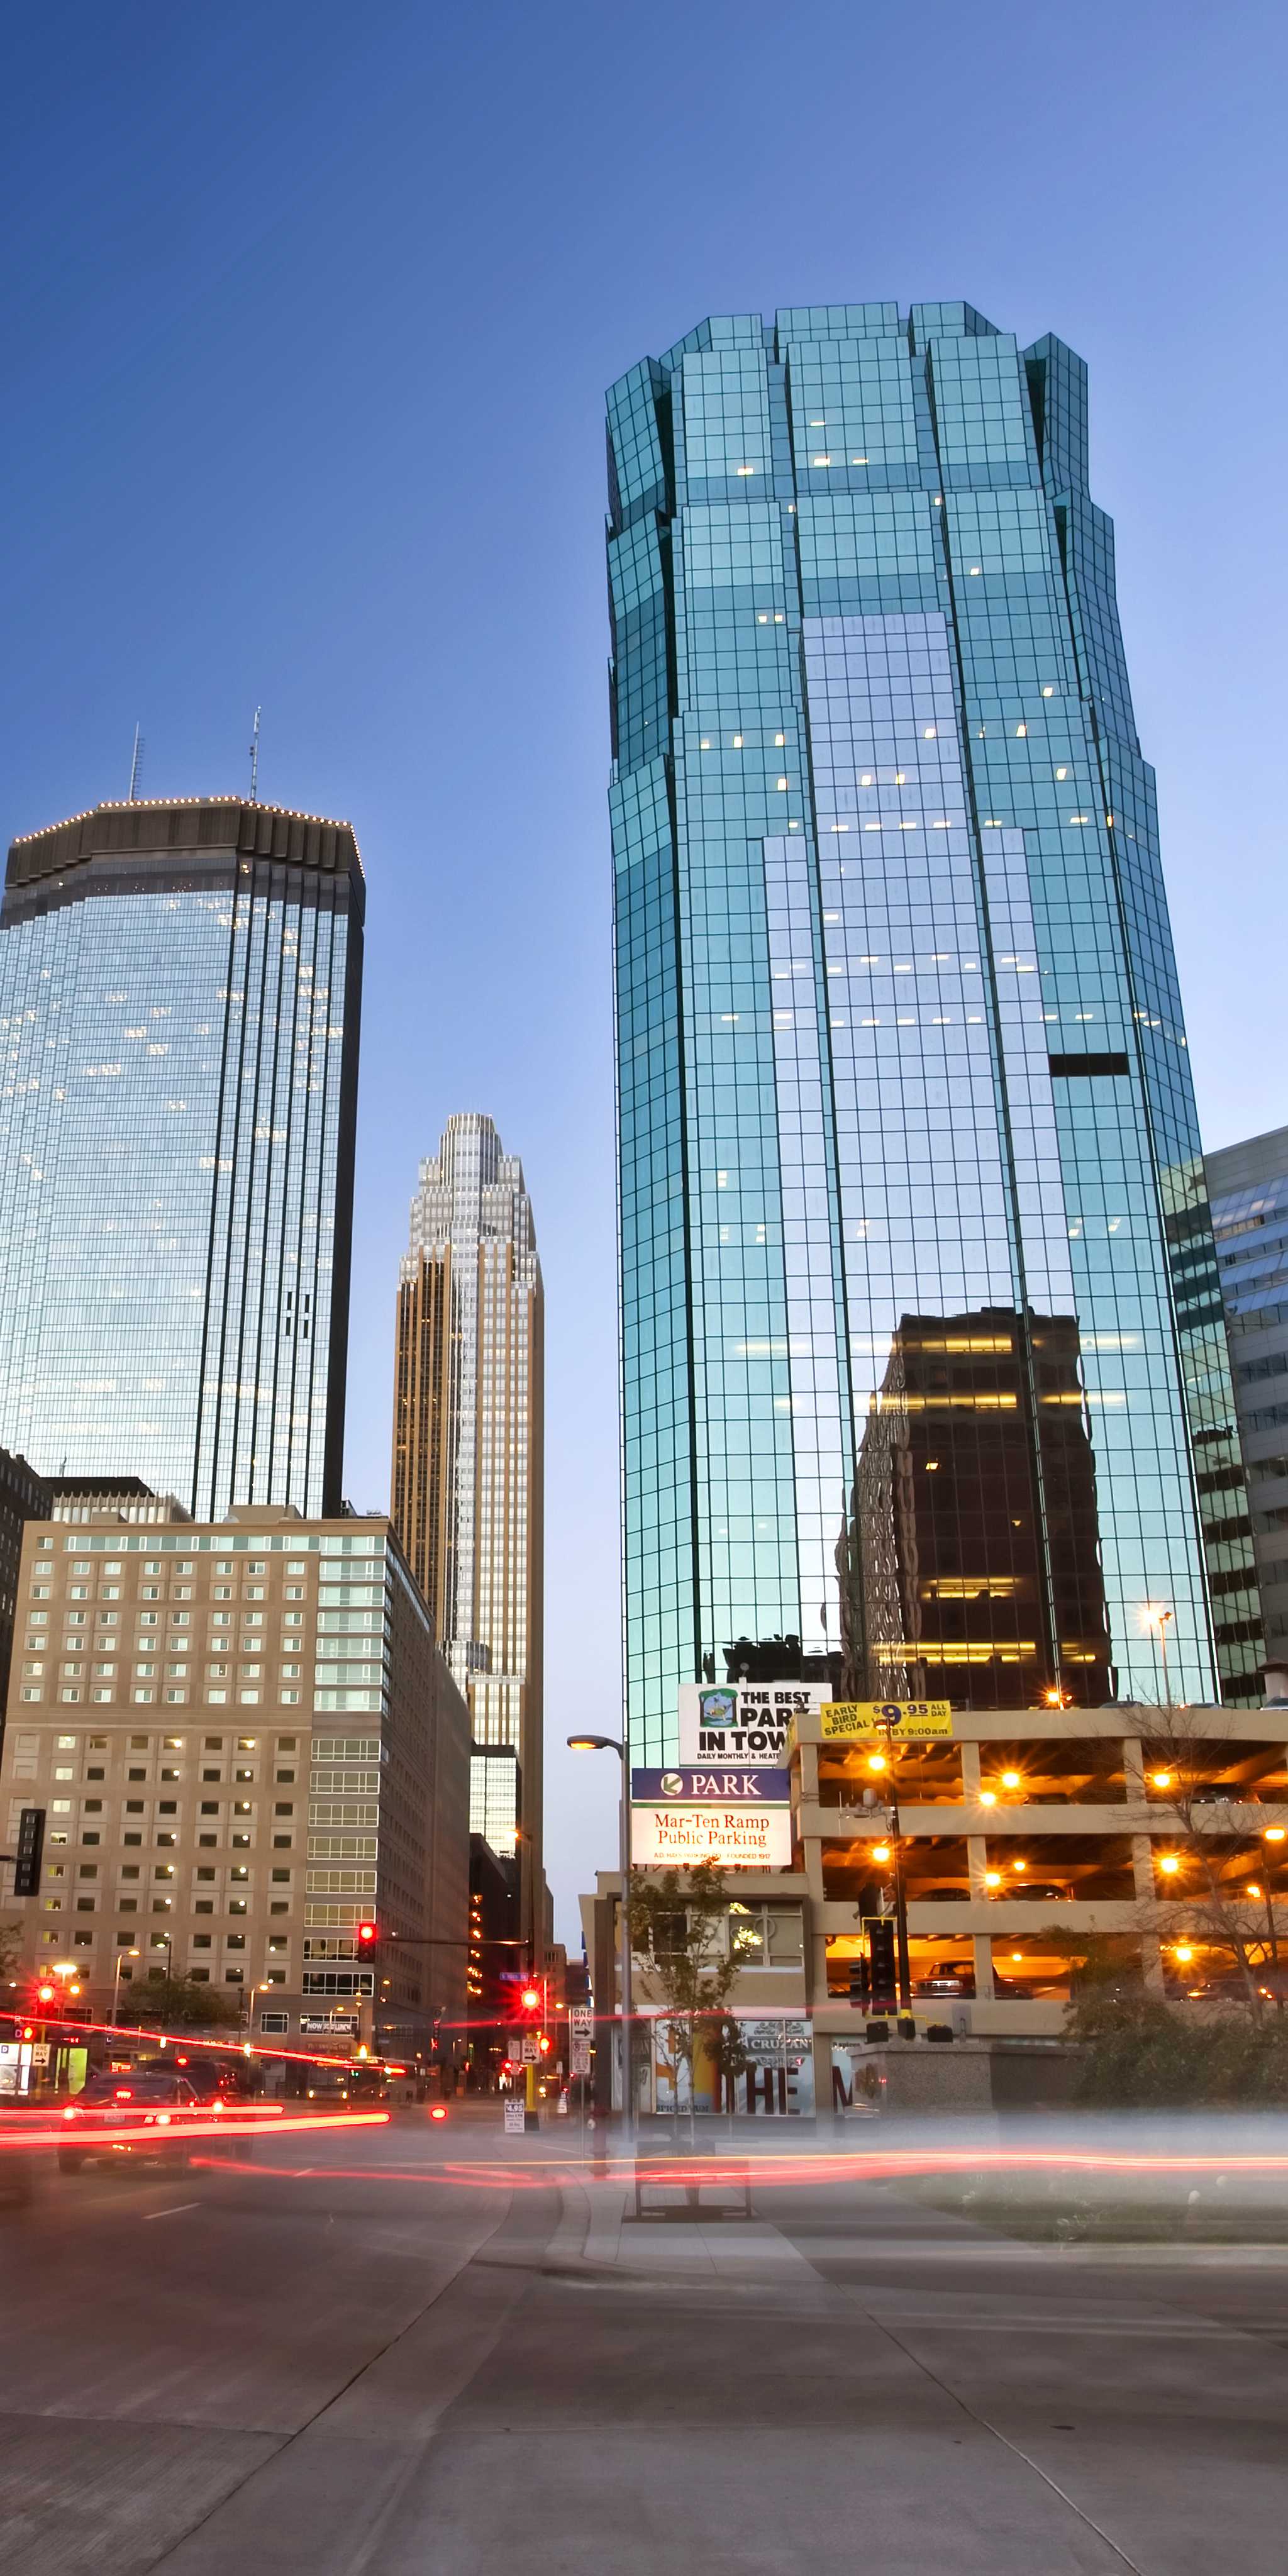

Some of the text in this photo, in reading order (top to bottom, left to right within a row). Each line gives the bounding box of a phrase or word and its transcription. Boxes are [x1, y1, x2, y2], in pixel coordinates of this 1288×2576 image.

[741, 1692, 811, 1704] THE BEST
[740, 1707, 810, 1727] PAR
[826, 1704, 858, 1718] EARLY
[832, 1713, 857, 1725] BIRD
[824, 1720, 870, 1736] SPECIAL
[908, 1728, 948, 1736] 9:00am
[699, 1731, 786, 1751] IN TOW
[691, 1774, 762, 1795] PARK
[654, 1814, 770, 1831] Mar-Ten Ramp
[658, 1831, 767, 1848] Public Parking
[750, 2038, 809, 2050] CRUZAN
